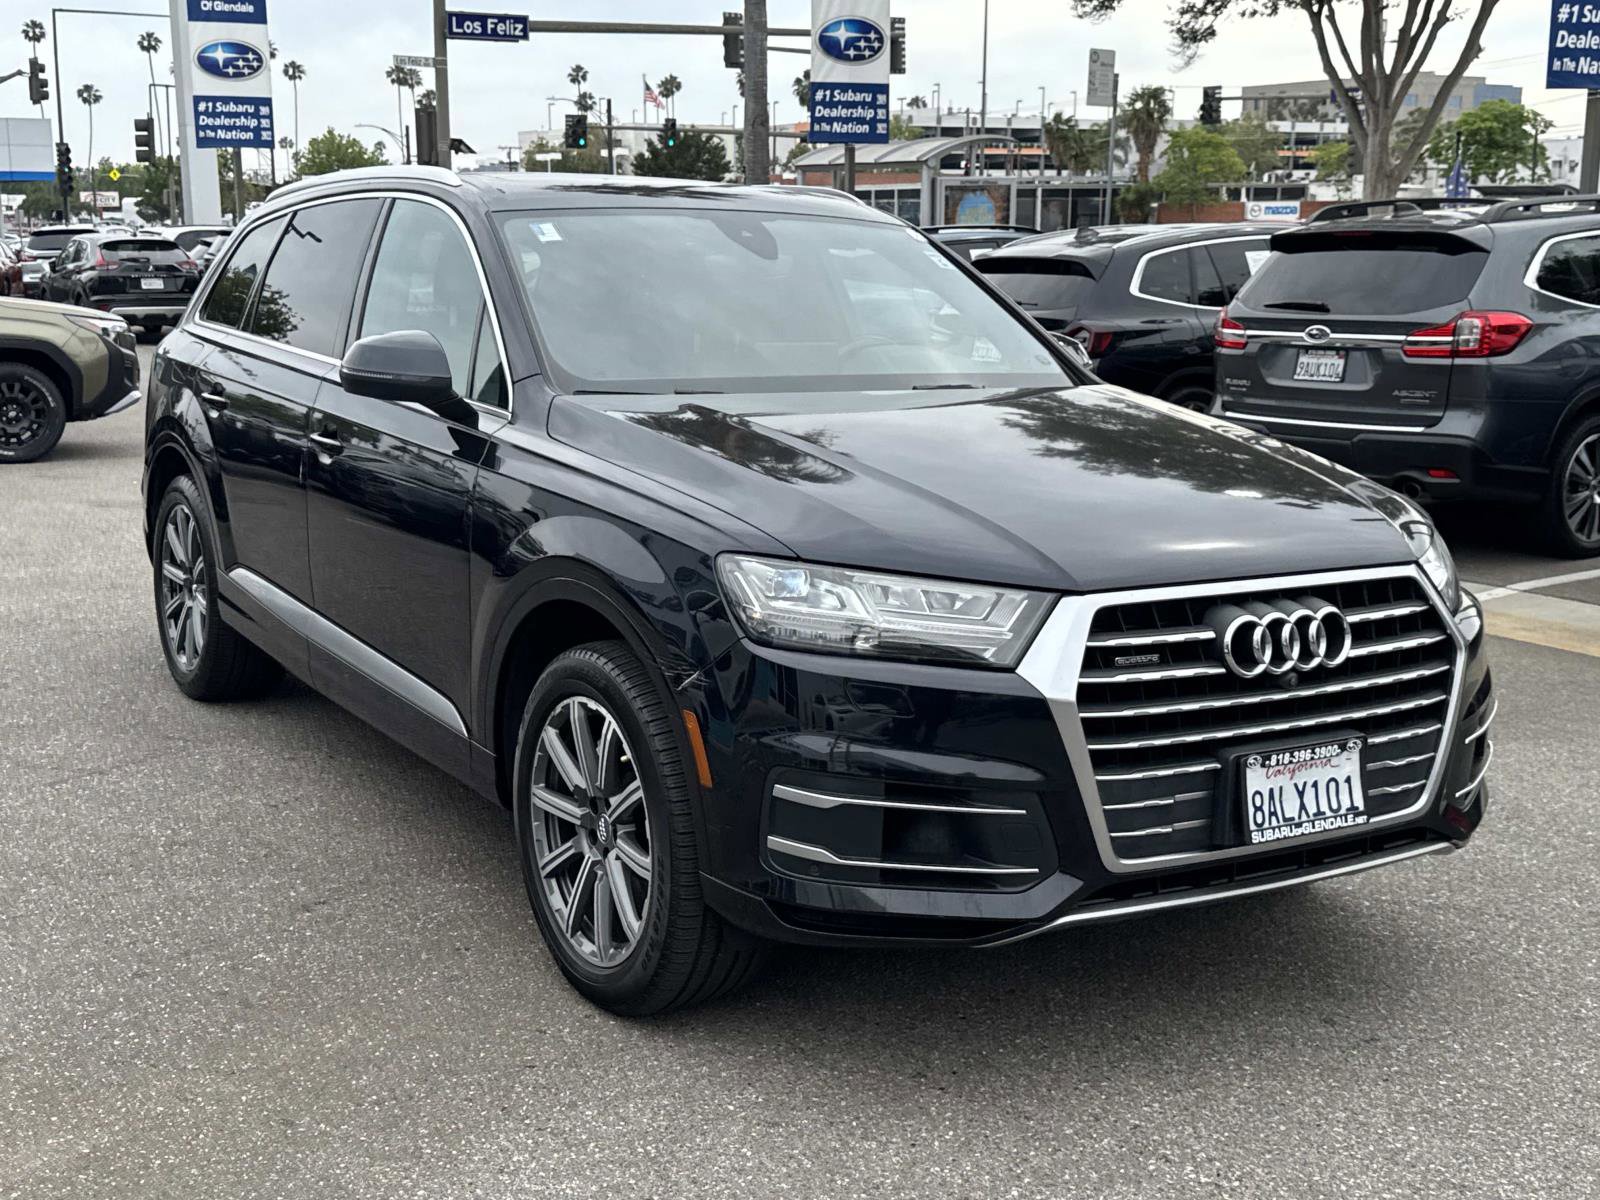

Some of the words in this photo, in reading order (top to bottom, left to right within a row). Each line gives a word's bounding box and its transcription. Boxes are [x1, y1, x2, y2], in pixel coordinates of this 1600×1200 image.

[200, 1, 213, 11] Of
[213, 1, 255, 13] Glendale
[1557, 3, 1580, 24] #1
[452, 16, 482, 34] Los
[486, 18, 524, 36] Feliz
[1552, 57, 1561, 72] In
[1562, 57, 1577, 72] The
[815, 89, 830, 102] #1
[833, 89, 872, 102] Subaru
[197, 101, 214, 113] #1
[214, 101, 255, 113] Subaru
[815, 105, 874, 120] Dealership
[199, 115, 258, 129] Dealership
[813, 122, 820, 132] In
[820, 121, 831, 132] The
[832, 121, 869, 133] Nation
[216, 128, 255, 140] Nation
[1296, 361, 1342, 377] 9AUK104
[1264, 758, 1341, 781] California
[1251, 774, 1360, 829] 8ALX101
